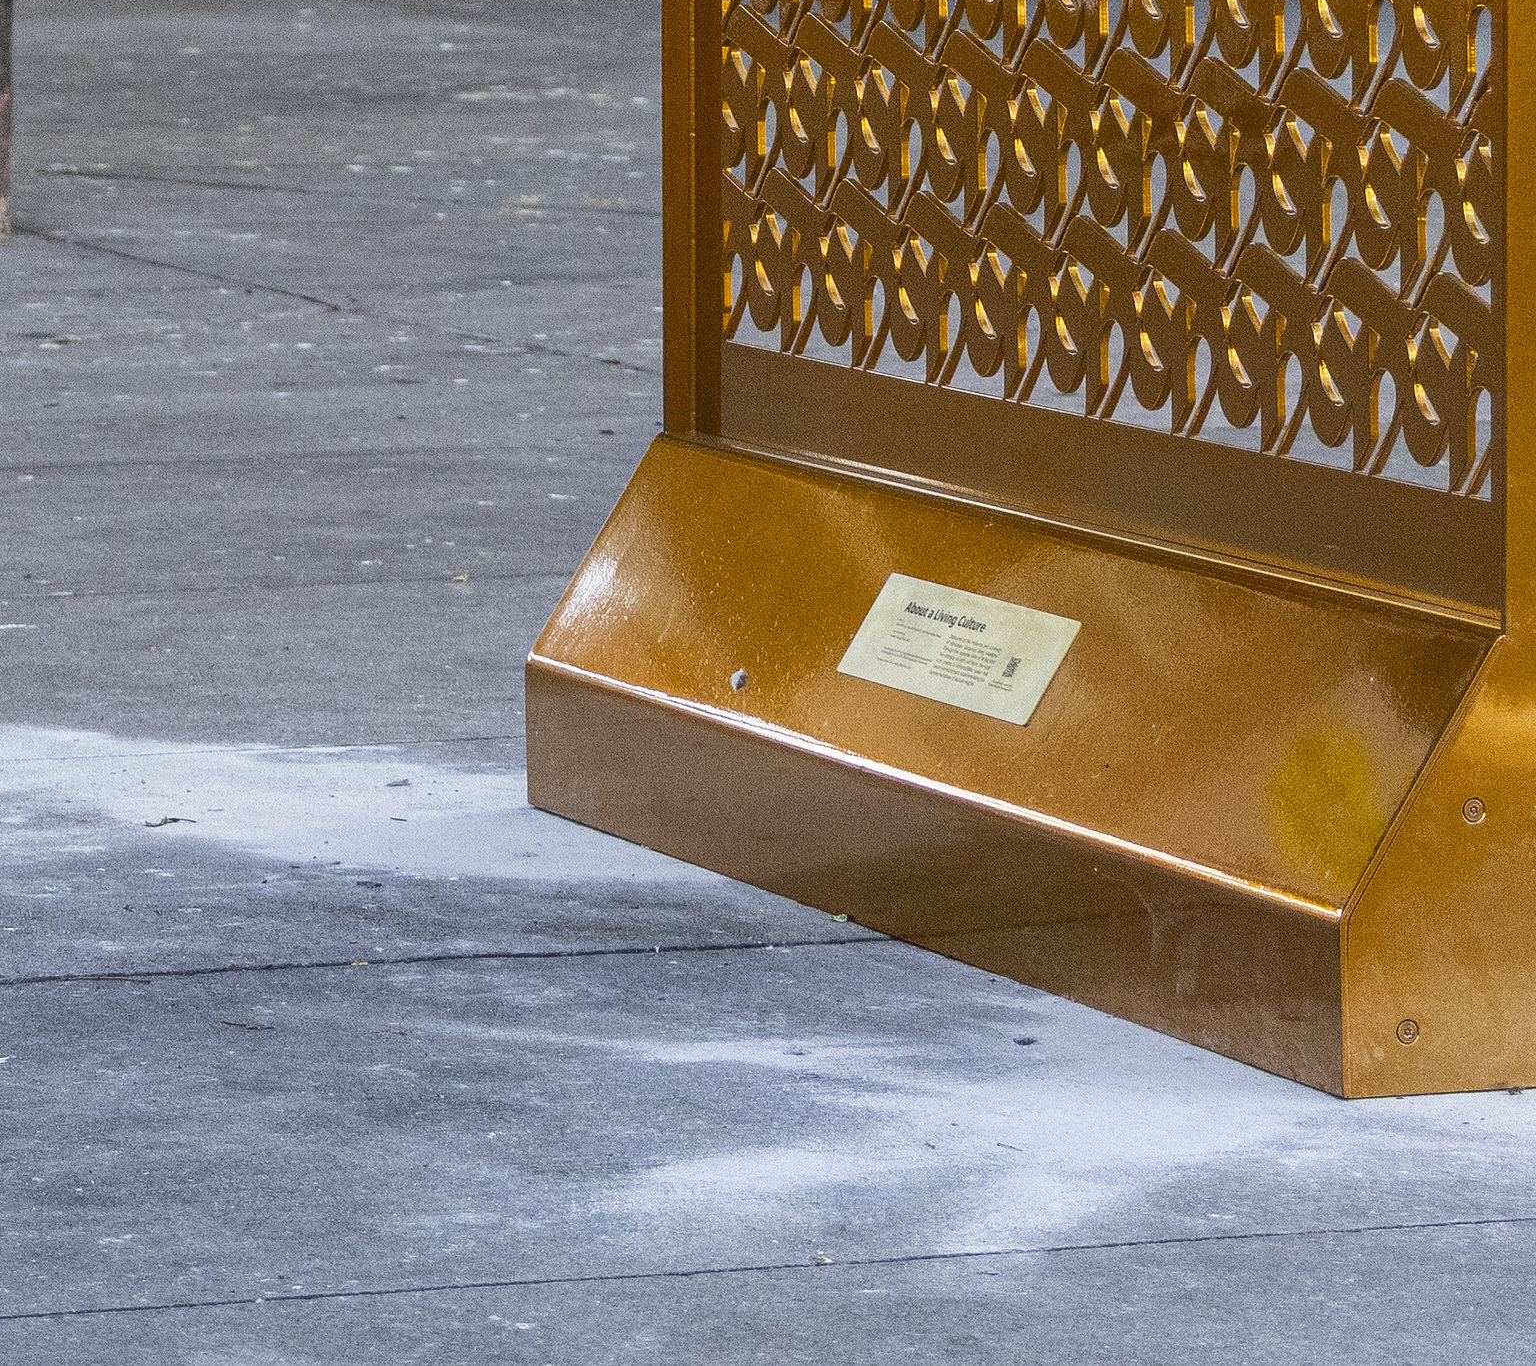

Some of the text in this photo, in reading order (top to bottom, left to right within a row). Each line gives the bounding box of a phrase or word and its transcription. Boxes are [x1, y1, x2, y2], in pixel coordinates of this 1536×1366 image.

[904, 601, 987, 634] About a Living Culture
